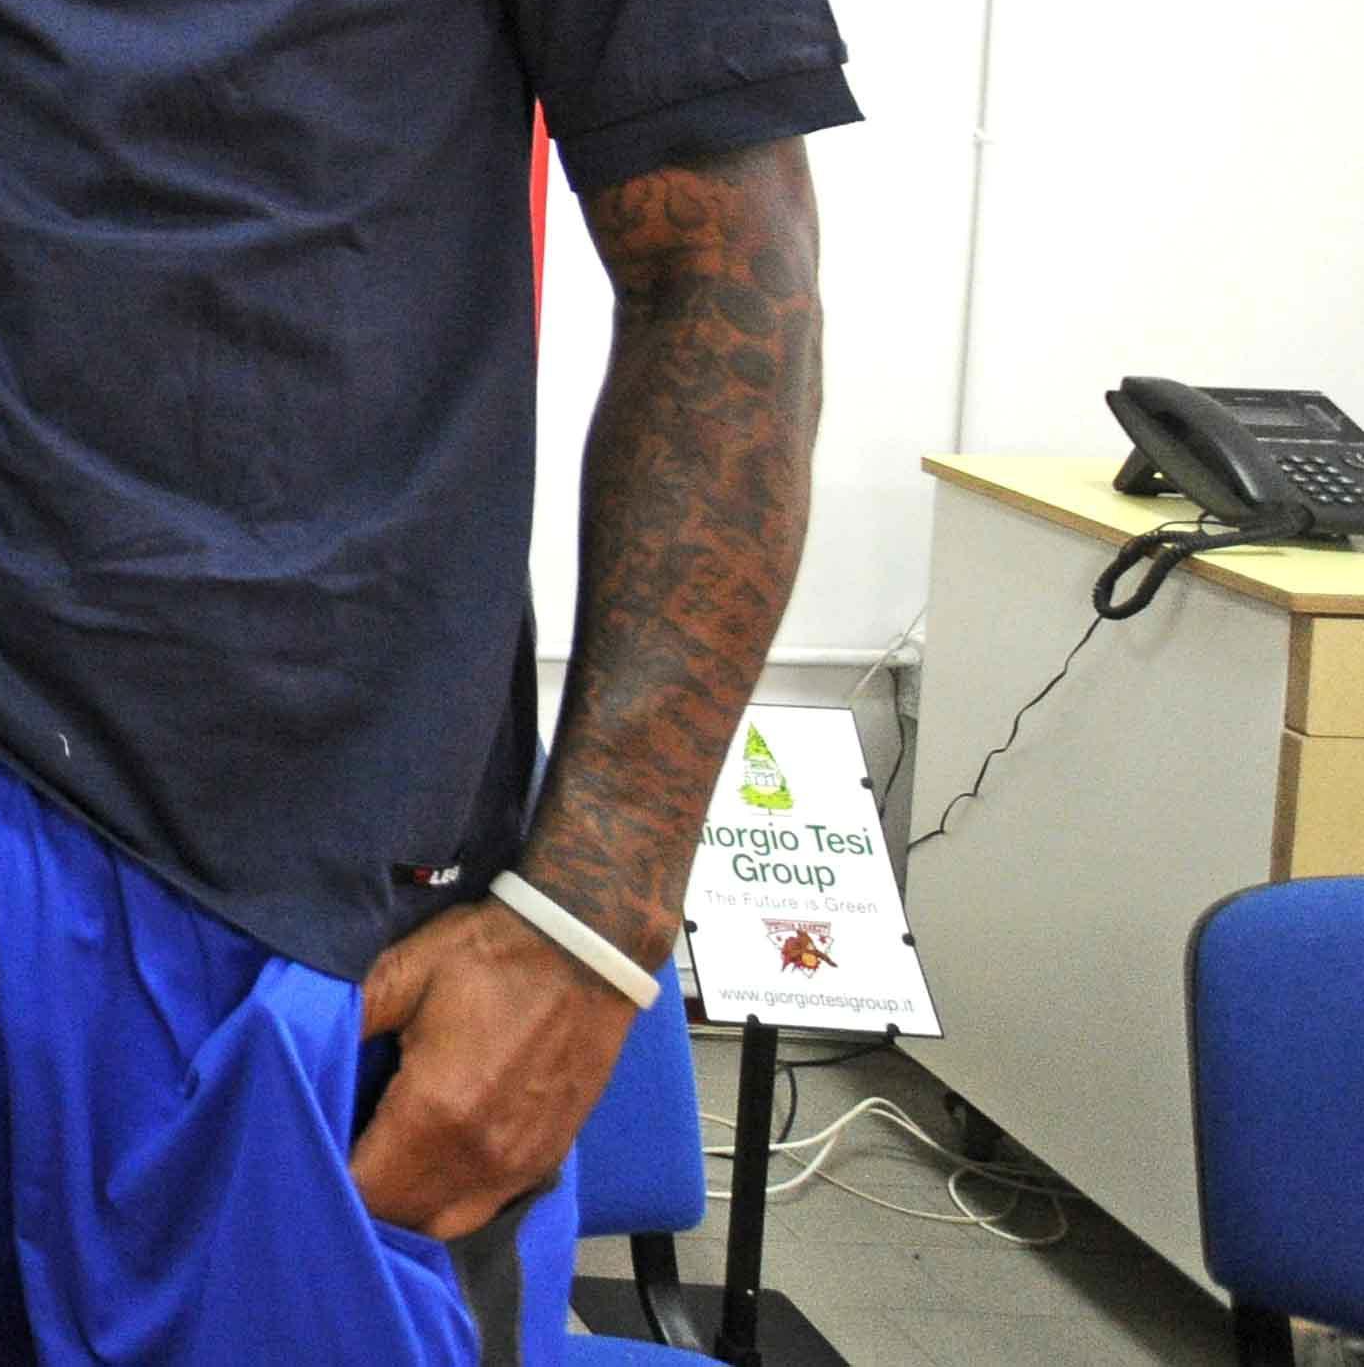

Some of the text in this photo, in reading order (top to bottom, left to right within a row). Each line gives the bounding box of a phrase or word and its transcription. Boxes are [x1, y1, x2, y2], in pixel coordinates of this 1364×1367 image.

[702, 818, 875, 856] iorgio Tesi
[732, 853, 836, 893] Group
[705, 890, 878, 914] The Future is Green
